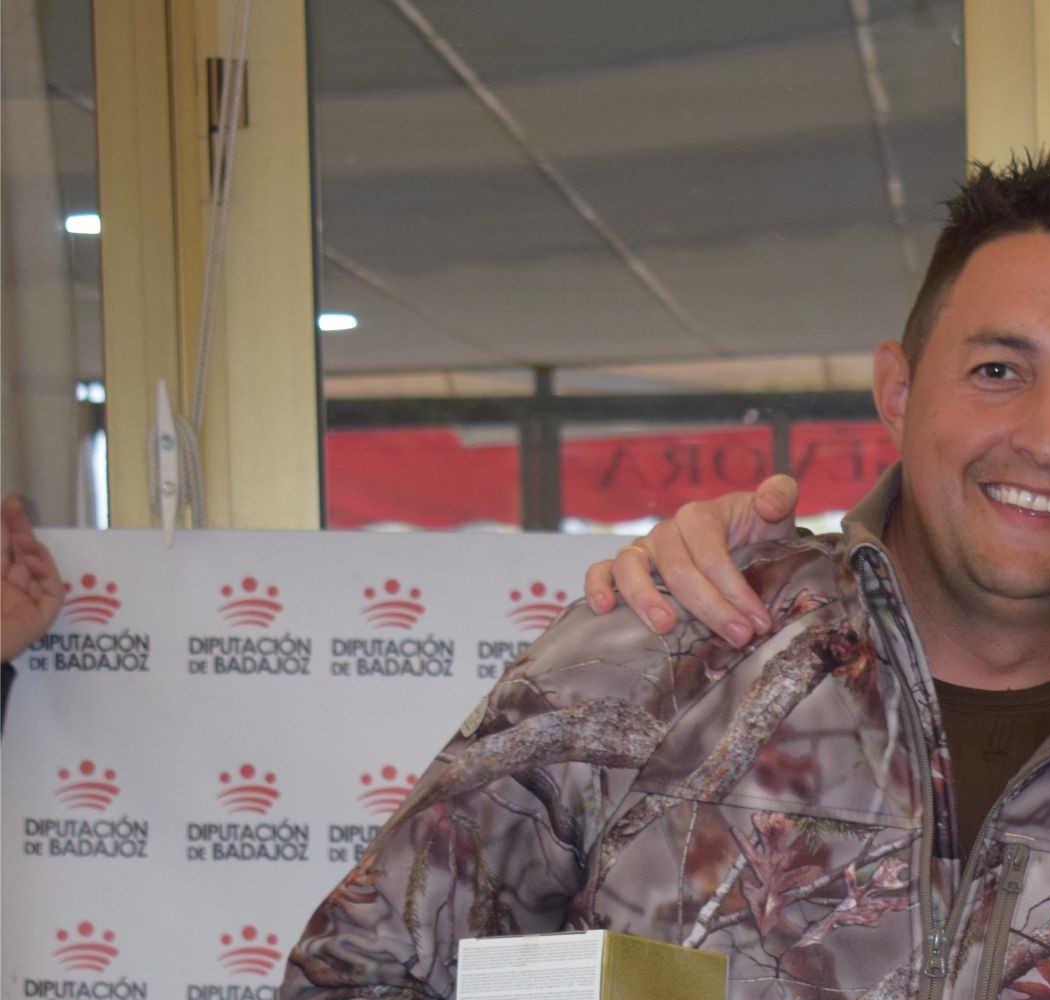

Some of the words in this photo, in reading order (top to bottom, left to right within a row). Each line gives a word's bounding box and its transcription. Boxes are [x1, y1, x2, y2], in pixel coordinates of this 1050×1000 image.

[30, 627, 150, 653] DIPUTACIÓN
[189, 632, 312, 656] DIPUTACIÓN
[332, 634, 454, 658] DIPUTACIÓN
[30, 656, 48, 671] DE
[55, 653, 150, 672] BADAJOZ
[189, 661, 208, 675] DE
[215, 656, 312, 675] BADAJOZ
[332, 662, 350, 676] DE
[357, 658, 454, 677] BADAJOZ
[478, 664, 497, 678] DE
[25, 815, 148, 838] DIPUTACIÓN
[188, 818, 309, 842] DIPUTACIÓN
[25, 842, 43, 855] DE
[50, 839, 148, 858] BADAJOZ
[188, 847, 207, 860] DE
[213, 842, 309, 861] BADAJOZ
[329, 848, 346, 861] DE
[24, 977, 147, 1000] DIPUTACIÓN
